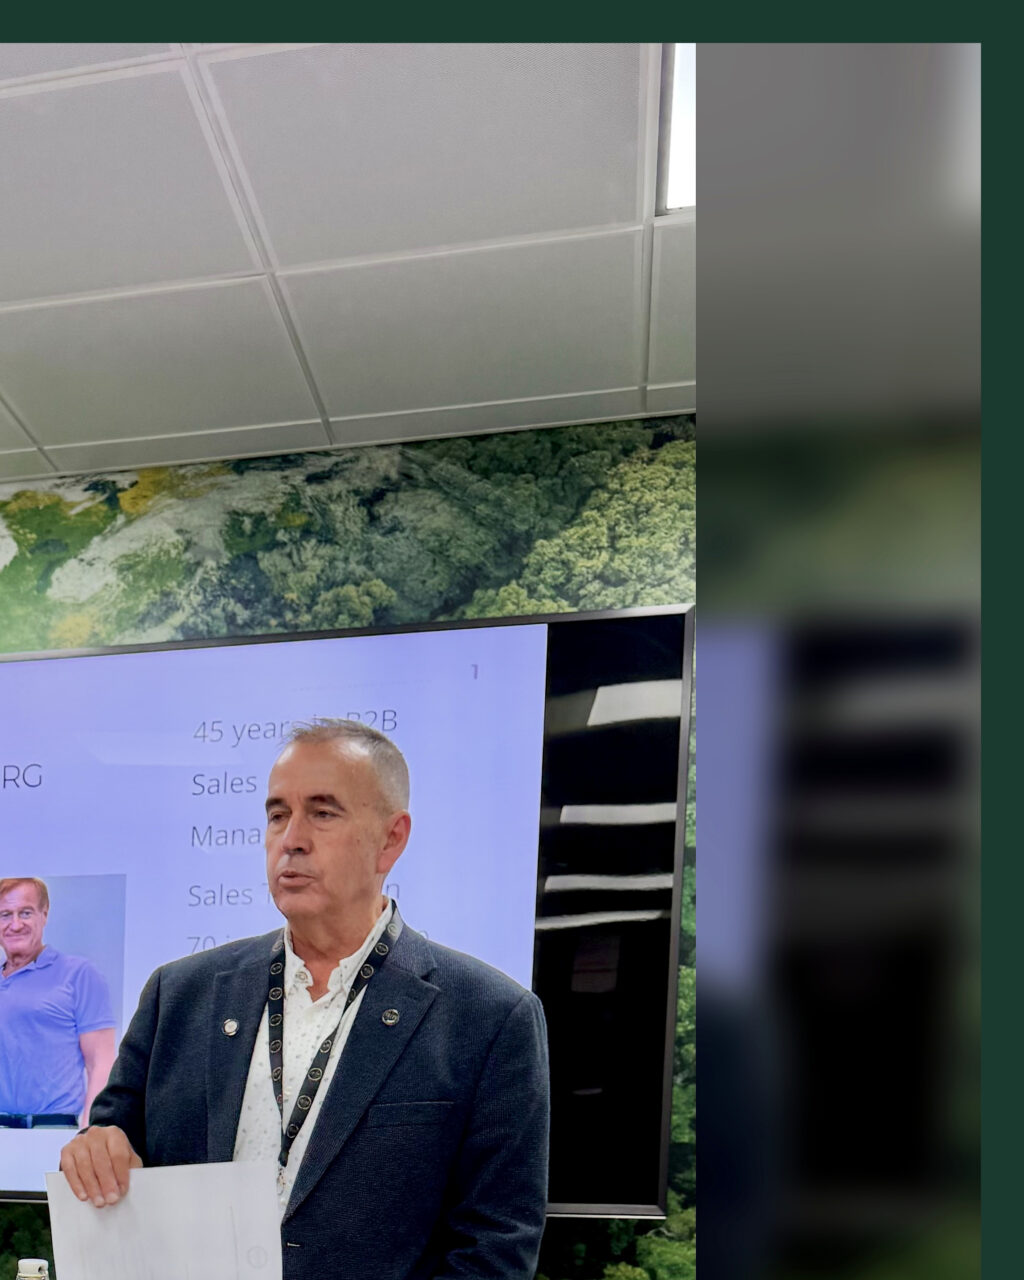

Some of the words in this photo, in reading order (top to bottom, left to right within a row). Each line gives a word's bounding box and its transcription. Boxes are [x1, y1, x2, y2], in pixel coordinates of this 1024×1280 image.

[471, 663, 478, 680] 1
[193, 720, 223, 743] 45
[191, 771, 257, 796] Sales
[191, 825, 262, 848] Mana
[188, 883, 253, 907] Sales
